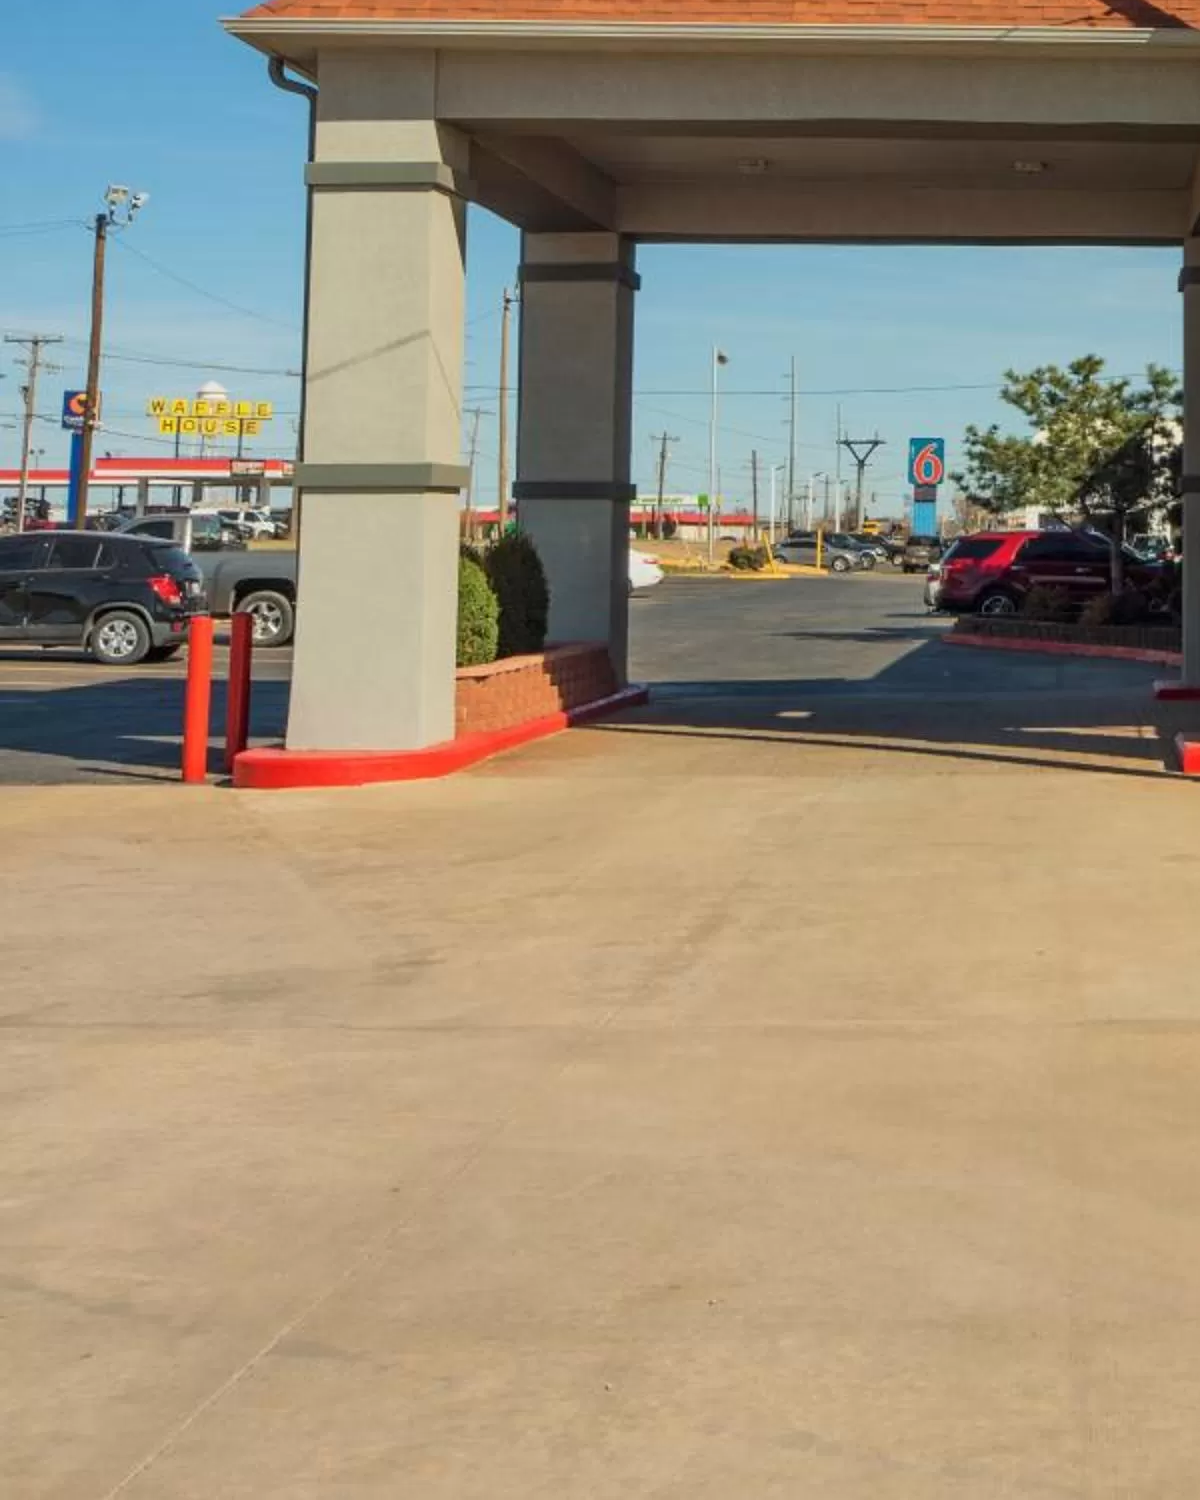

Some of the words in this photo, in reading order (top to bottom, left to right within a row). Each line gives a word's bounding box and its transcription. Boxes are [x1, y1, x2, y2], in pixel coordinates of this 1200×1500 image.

[151, 398, 269, 417] WAFFLE
[161, 418, 258, 435] HOUSE
[913, 442, 943, 485] 6
